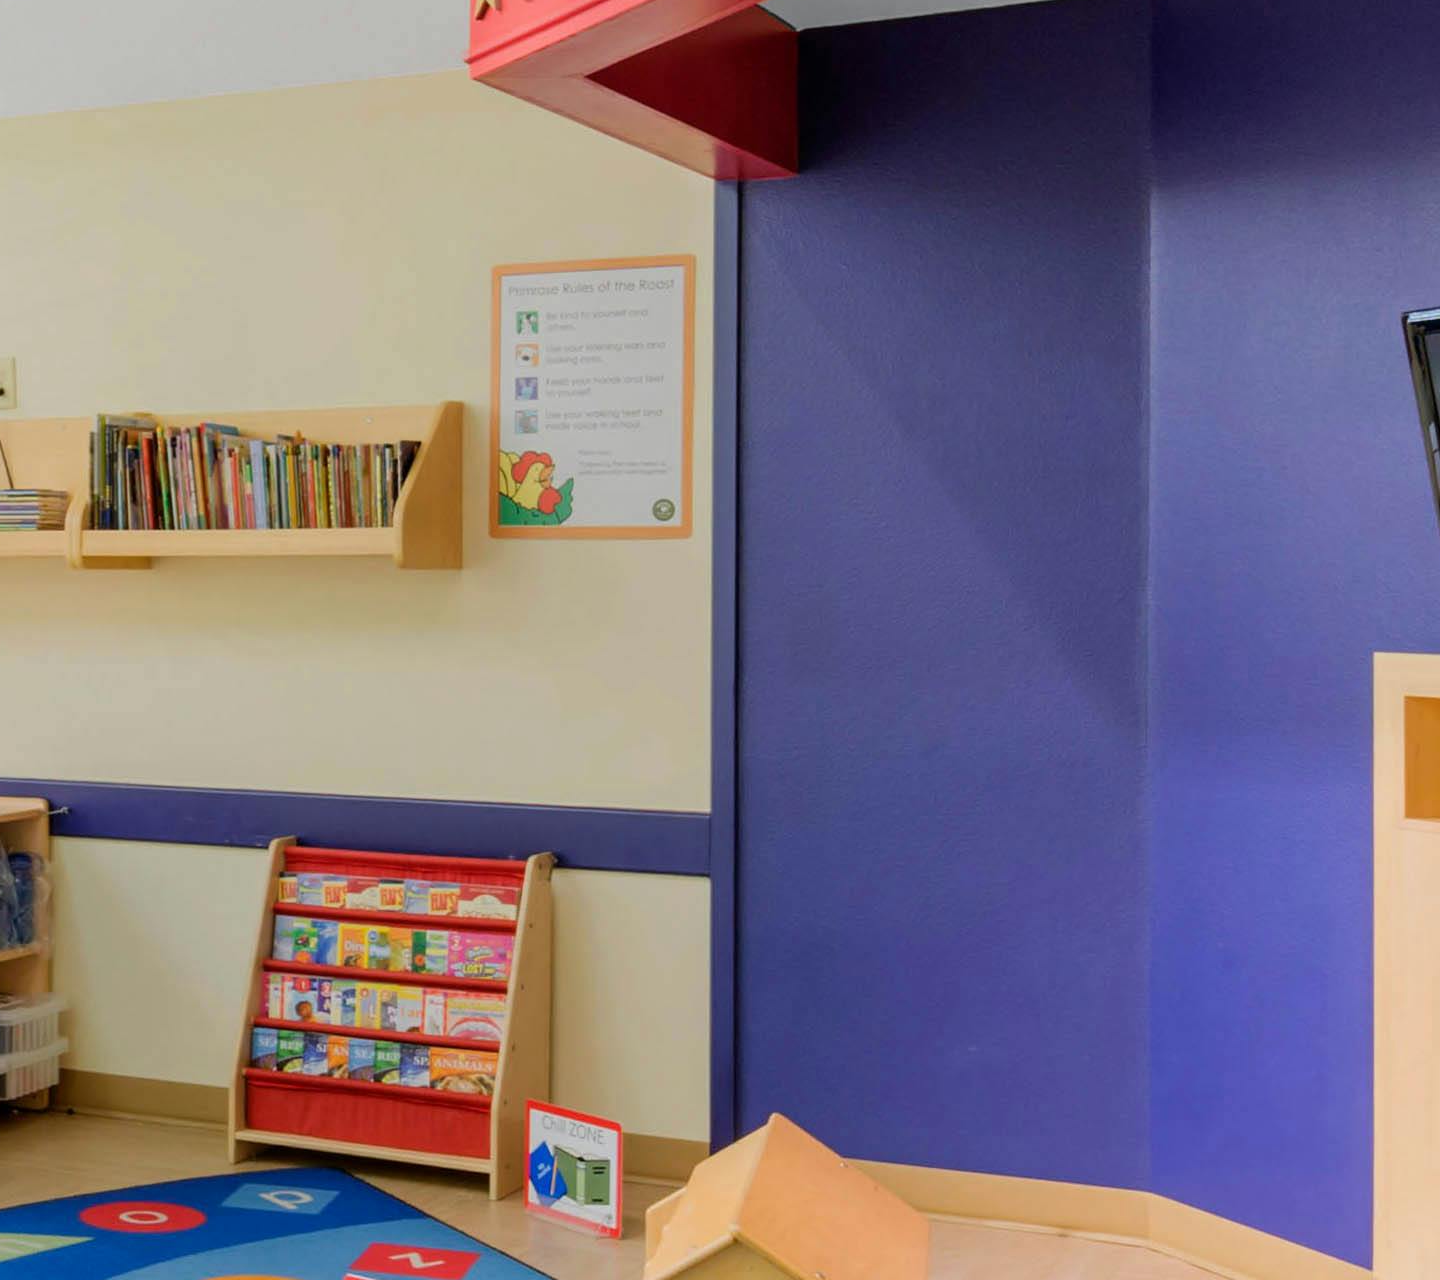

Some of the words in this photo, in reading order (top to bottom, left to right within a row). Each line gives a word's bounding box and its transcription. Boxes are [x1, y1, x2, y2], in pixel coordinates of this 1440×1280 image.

[509, 284, 560, 297] Primrose
[562, 282, 594, 295] Rules
[598, 281, 611, 293] of
[614, 280, 635, 292] the
[639, 278, 675, 291] Roost
[433, 1058, 494, 1073] ANIMALS
[568, 1122, 607, 1145] ZONE
[258, 1190, 314, 1210] p
[119, 1211, 168, 1224] o
[389, 1253, 445, 1270] z
